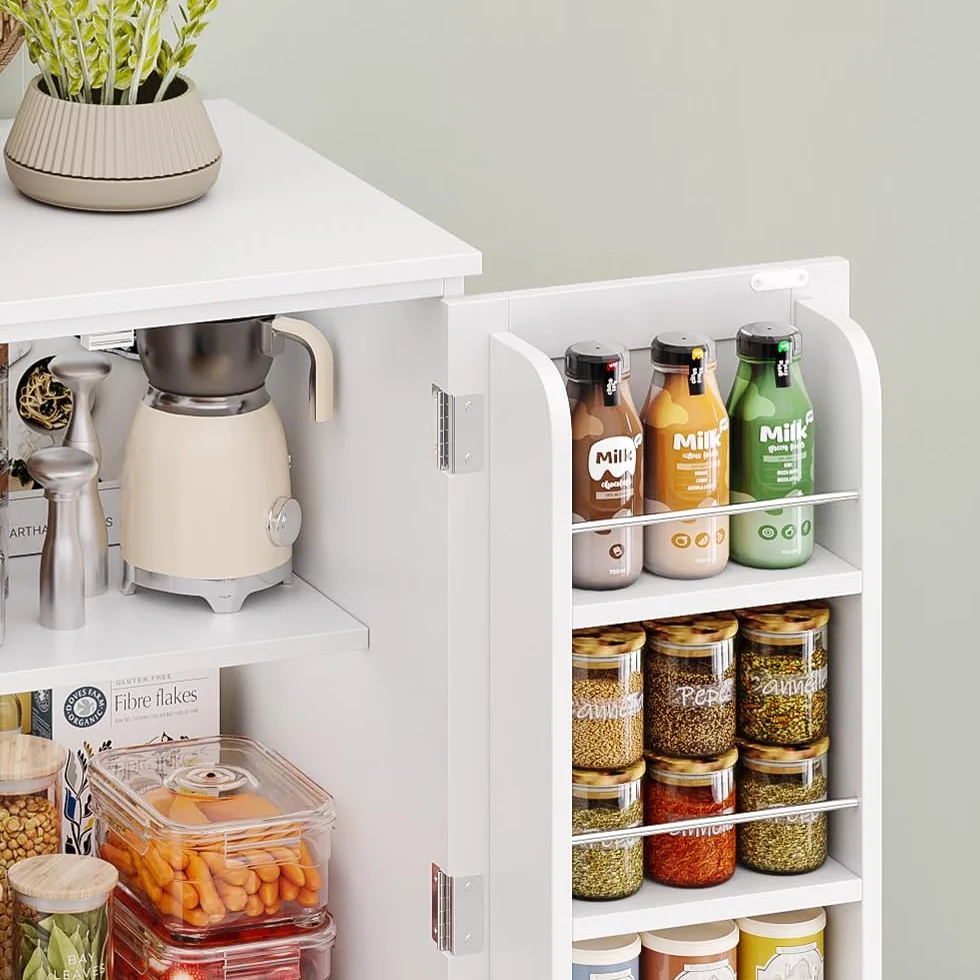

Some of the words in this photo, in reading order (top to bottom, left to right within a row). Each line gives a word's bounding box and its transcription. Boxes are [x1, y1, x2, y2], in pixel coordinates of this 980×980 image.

[673, 428, 721, 450] Milk
[760, 422, 807, 443] Milk
[596, 448, 633, 464] Milk
[116, 675, 149, 685] GLUTEN
[151, 673, 172, 682] FREE
[66, 688, 87, 711] DOVES
[88, 689, 104, 707] FARM
[115, 692, 152, 712] Fibre
[156, 686, 198, 707] flakes
[68, 709, 103, 726] ORGANIC
[68, 952, 95, 965] BAY
[53, 963, 105, 980] LEAVES
